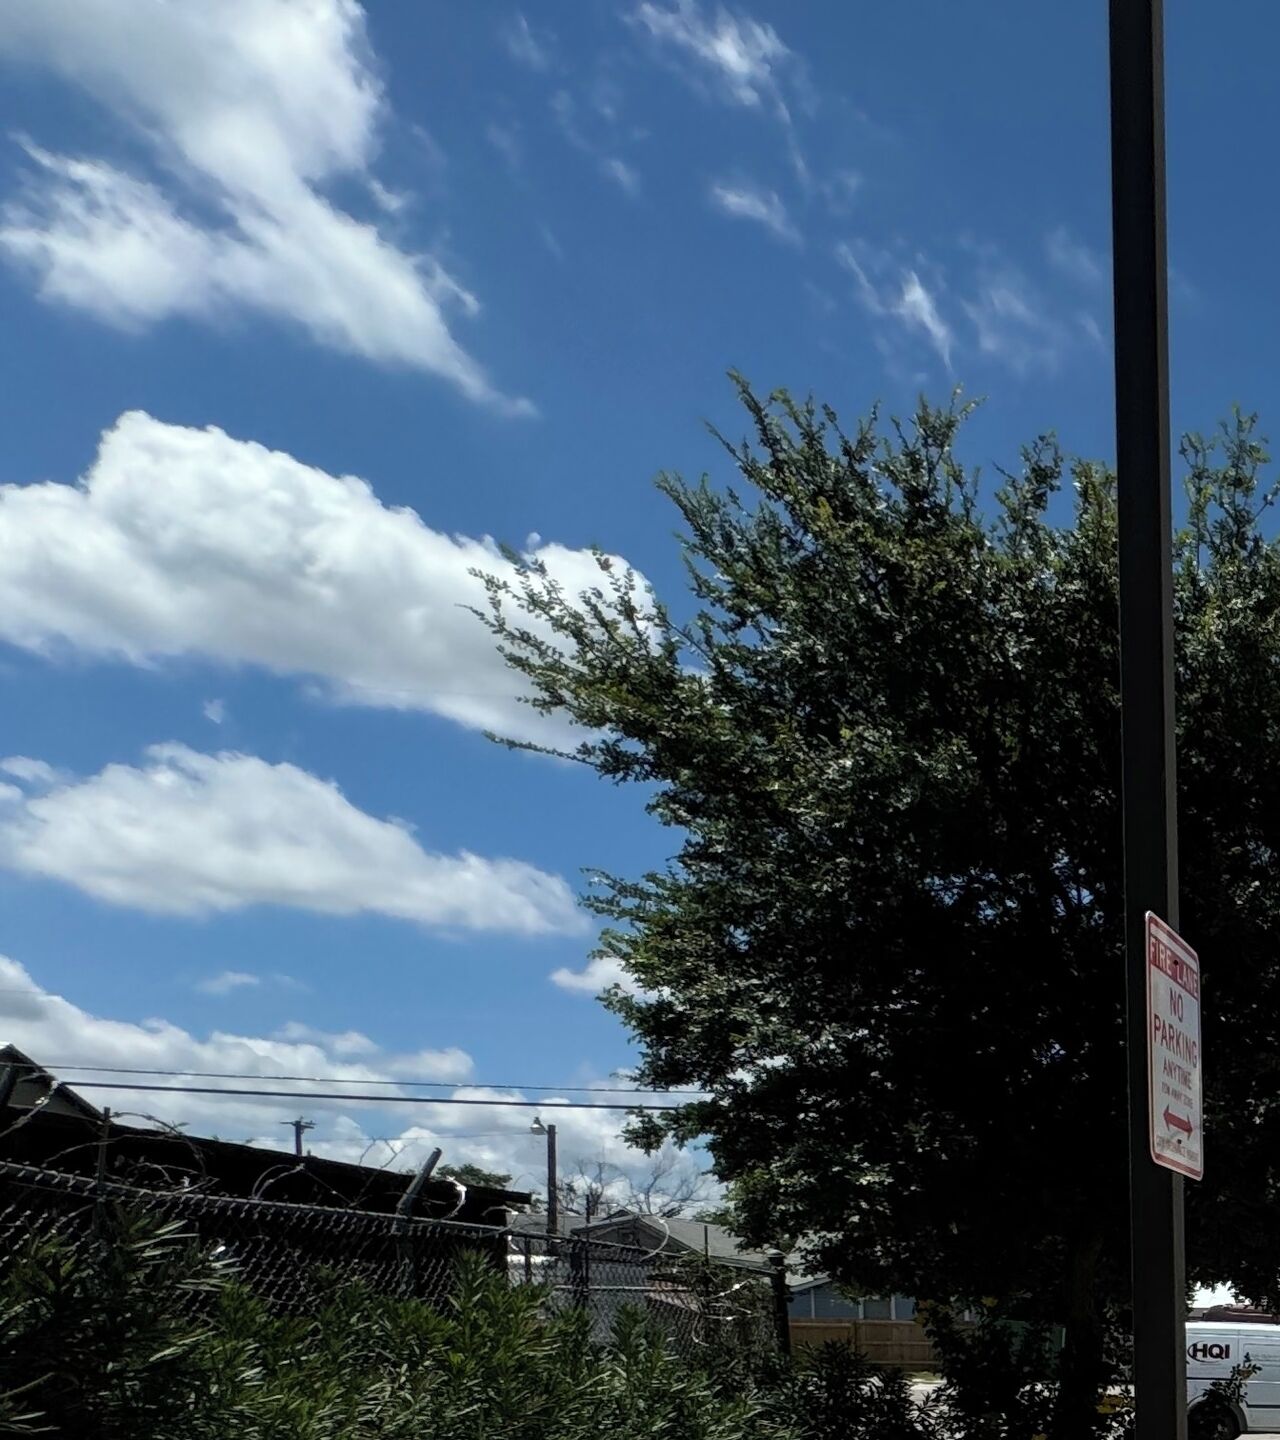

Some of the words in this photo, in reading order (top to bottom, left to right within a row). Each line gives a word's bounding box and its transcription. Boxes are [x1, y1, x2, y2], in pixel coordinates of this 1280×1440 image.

[1150, 937, 1171, 976] FIRE
[1176, 962, 1198, 997] LANE
[1169, 987, 1184, 1023] NO
[1153, 1013, 1198, 1069] PARKING
[1192, 1343, 1231, 1360] HQI
